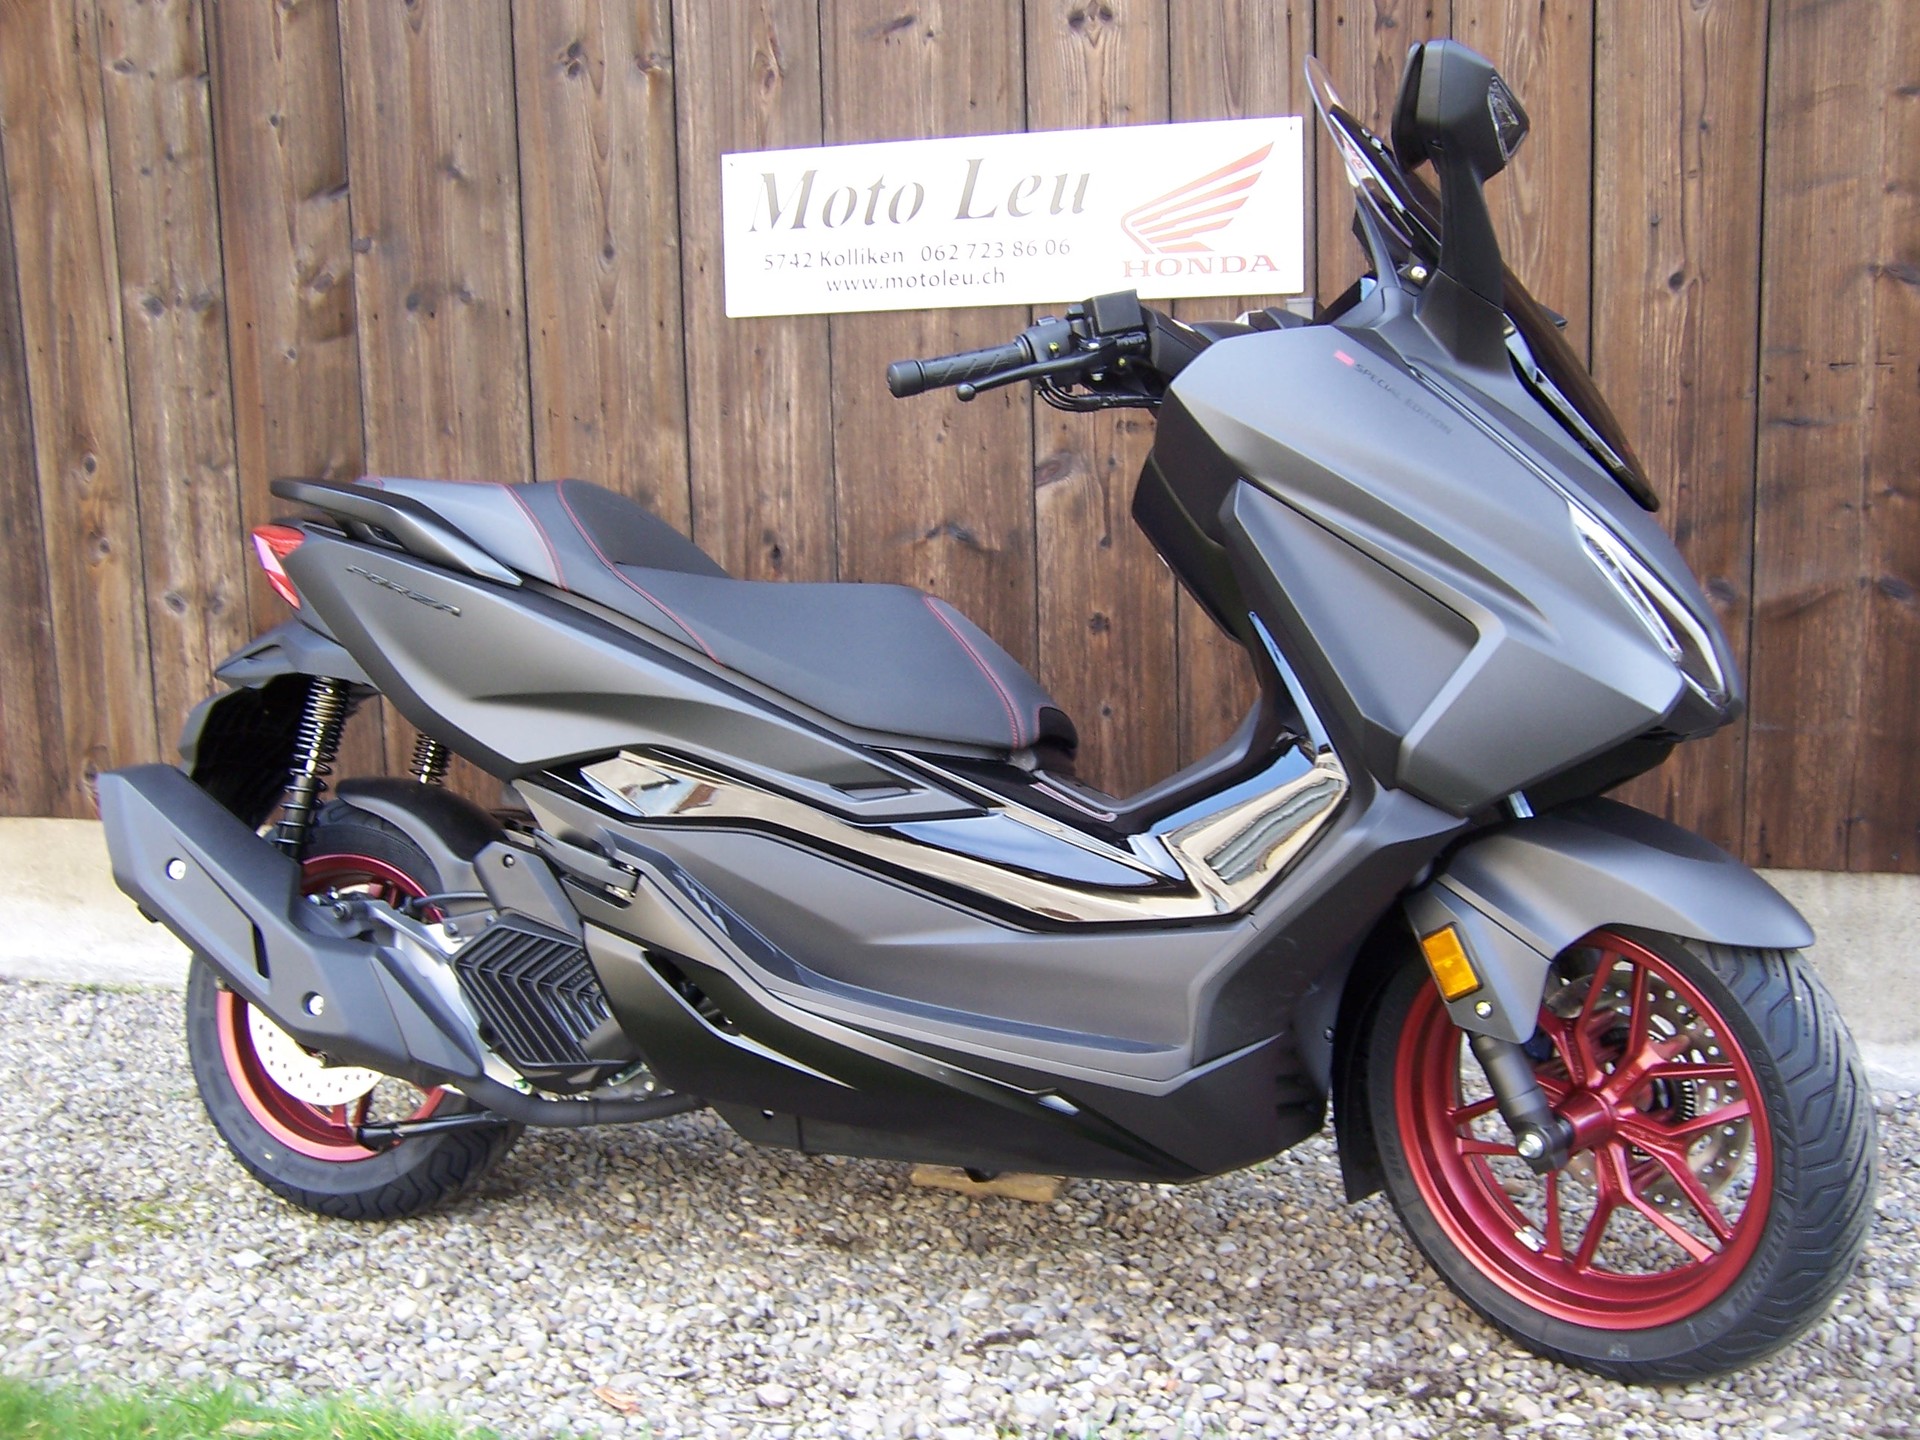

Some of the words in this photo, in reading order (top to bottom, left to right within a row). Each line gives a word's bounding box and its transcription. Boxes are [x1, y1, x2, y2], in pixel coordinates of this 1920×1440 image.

[747, 168, 925, 233] Moto
[954, 158, 1092, 220] Leu
[763, 252, 812, 270] 5742
[919, 244, 959, 262] 062
[966, 241, 1005, 260] 723
[1011, 239, 1039, 258] 86
[1044, 238, 1072, 256] 06
[1122, 253, 1281, 279] HONDA
[826, 265, 1006, 292] www.motoleu.ch
